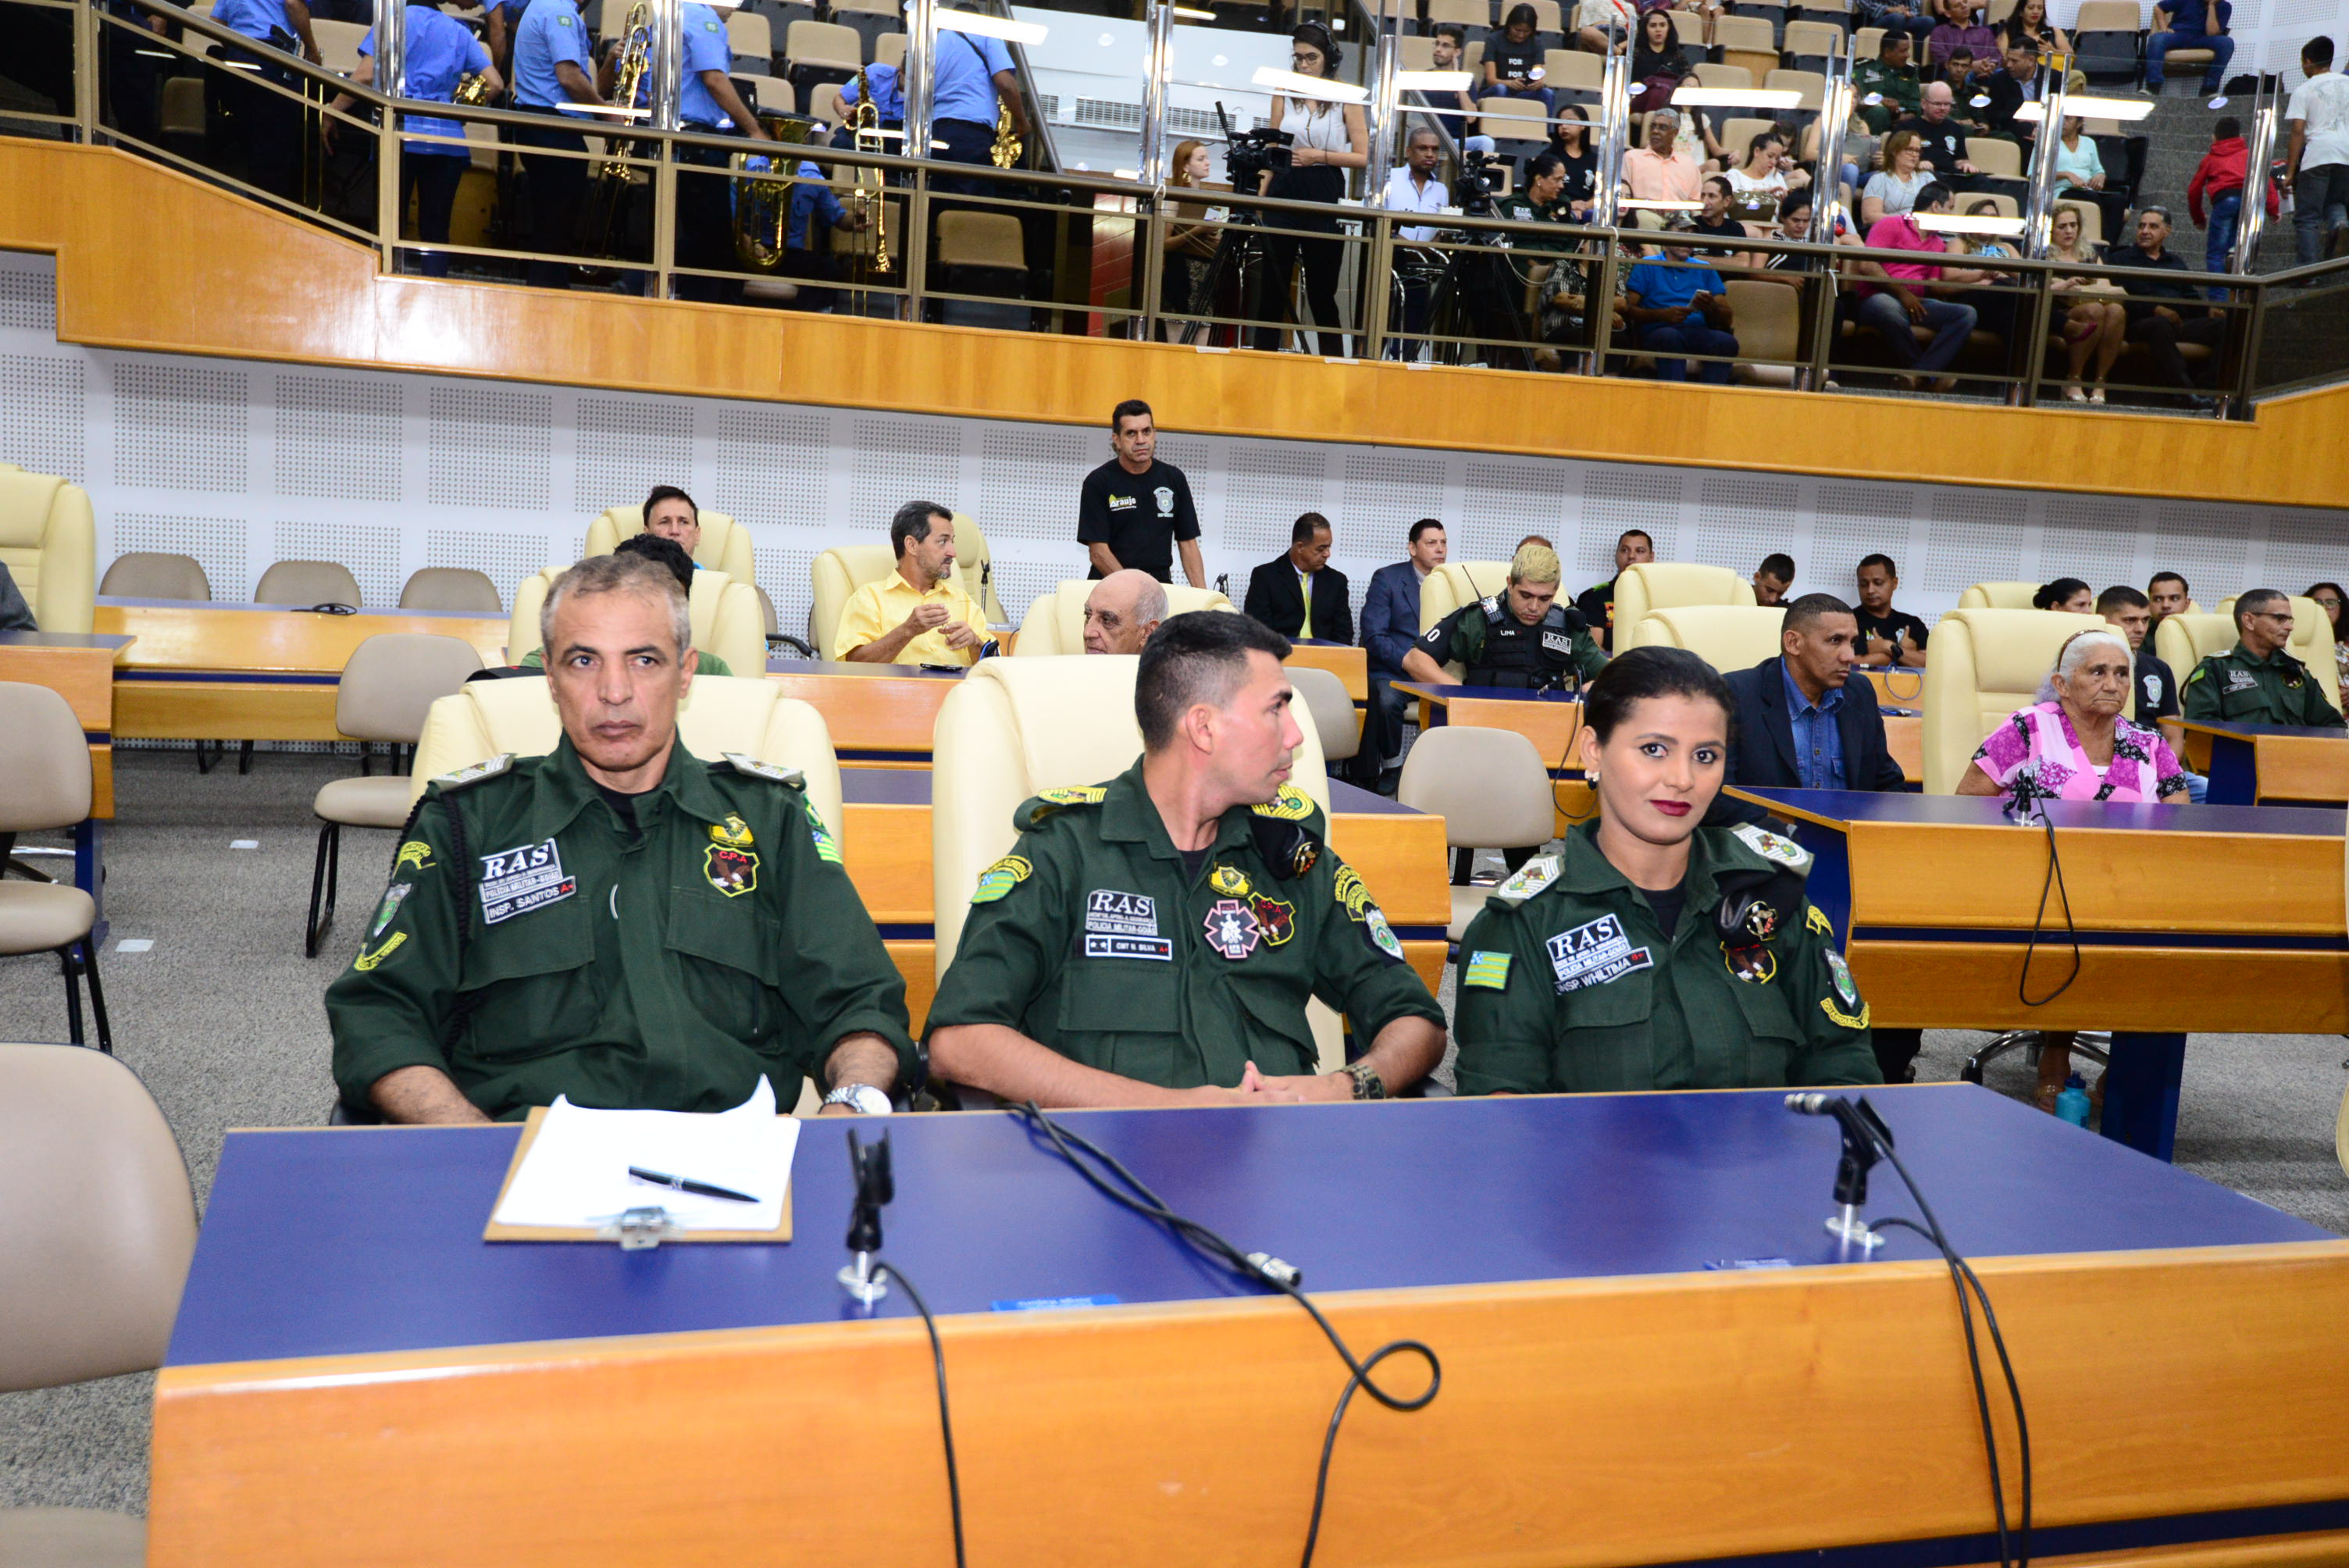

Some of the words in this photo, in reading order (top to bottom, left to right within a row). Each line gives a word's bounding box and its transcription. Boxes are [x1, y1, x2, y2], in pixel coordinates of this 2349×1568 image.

[1110, 496, 1137, 508] Araujo
[1545, 634, 1568, 646] RAS
[482, 844, 550, 881] RAS
[489, 902, 515, 918] INSP.
[515, 886, 561, 908] SANTOS
[1092, 892, 1151, 917] RAS
[1138, 943, 1157, 952] SILVA
[1554, 918, 1614, 960] RAS
[1581, 957, 1632, 986] WHILTIMA
